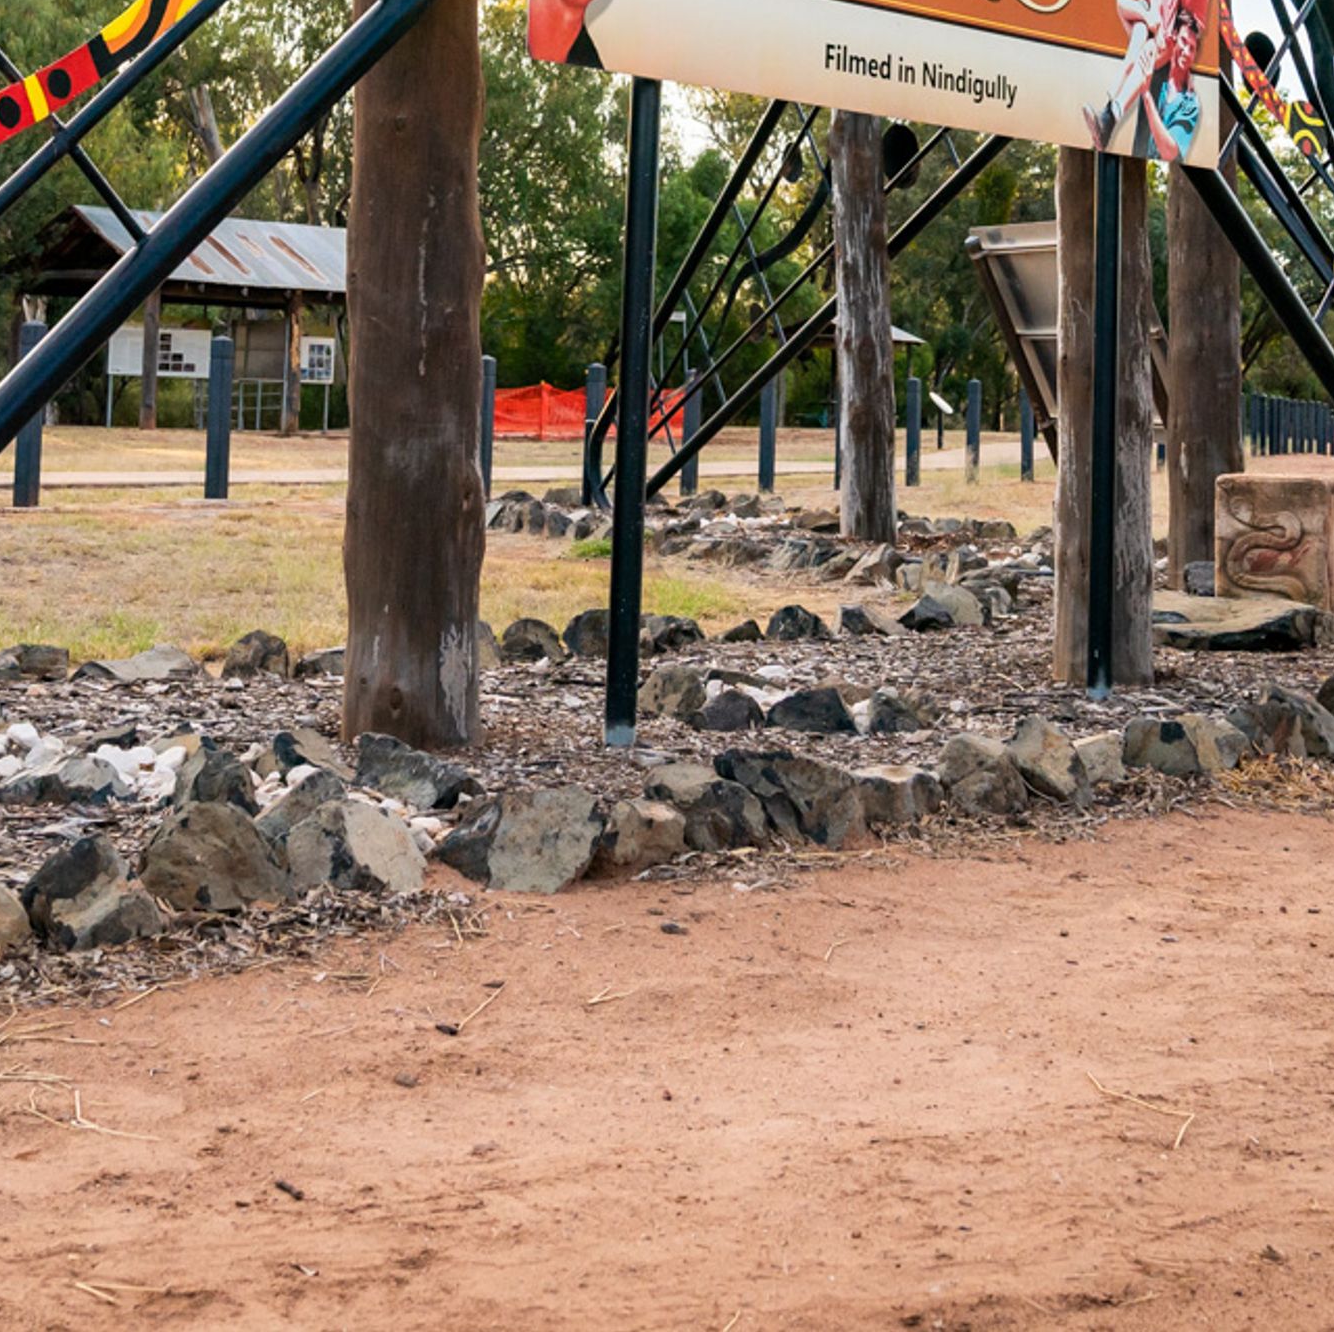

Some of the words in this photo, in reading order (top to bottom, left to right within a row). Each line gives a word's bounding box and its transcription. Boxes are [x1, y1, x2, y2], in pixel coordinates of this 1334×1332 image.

[825, 44, 892, 81] Filmed
[898, 56, 916, 85] in
[922, 61, 1018, 109] Nindigully
